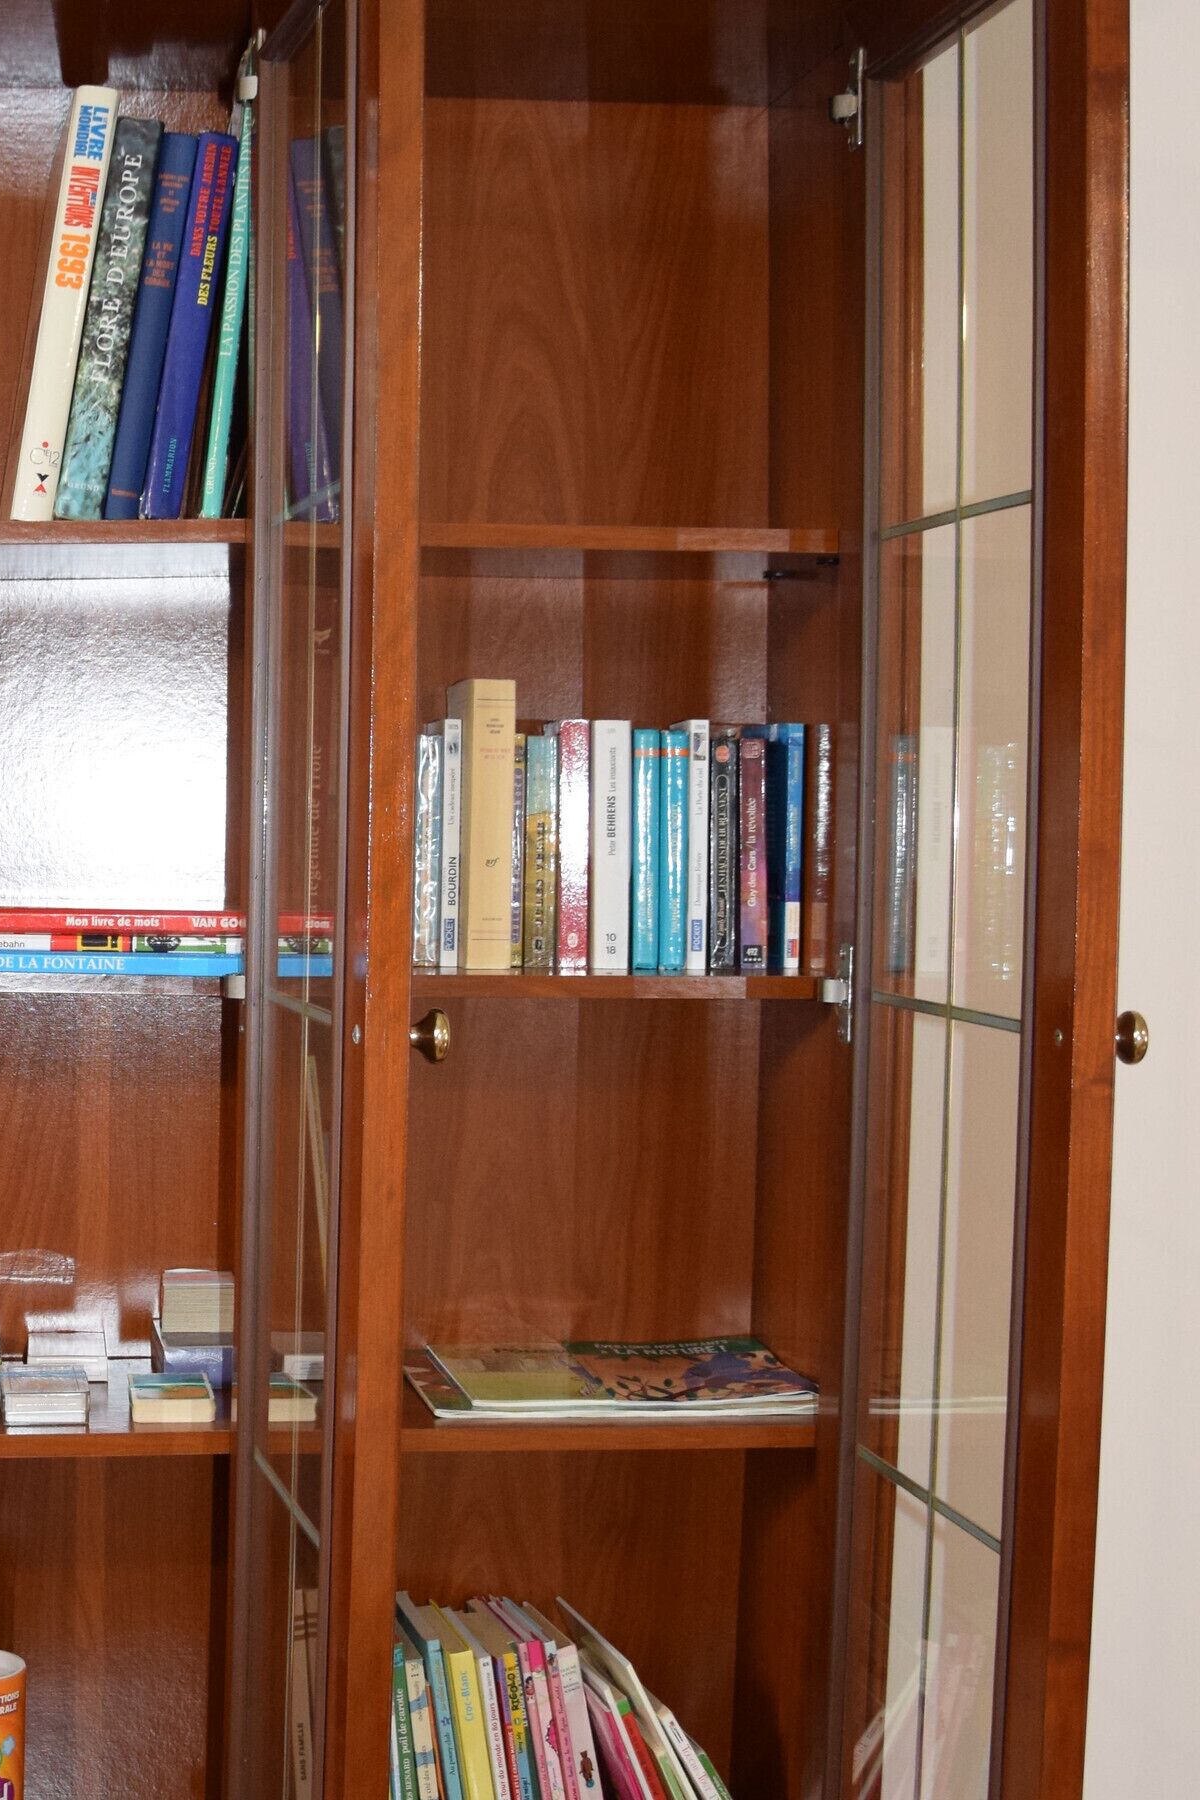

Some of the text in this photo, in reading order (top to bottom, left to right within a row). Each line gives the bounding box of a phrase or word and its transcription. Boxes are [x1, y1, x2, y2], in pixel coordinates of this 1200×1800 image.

[195, 189, 210, 226] VOTRE
[190, 225, 202, 257] DANS
[197, 194, 224, 306] DES FLEURS TOUTE
[55, 233, 91, 290] 1993
[91, 153, 143, 384] FLORE D'EUROPE
[220, 168, 249, 357] LA PASSION DES PLANTES
[606, 780, 617, 857] Peter BEHRENS Les
[747, 797, 757, 833] révoltée
[535, 822, 545, 928] JULES VERNE
[747, 850, 757, 871] Cars
[447, 856, 458, 906] BOURDIN
[747, 871, 757, 887] des
[747, 888, 758, 906] Guy
[65, 915, 218, 929] Mon livre de mots VAN
[444, 918, 455, 951] POCKET
[606, 933, 617, 941] 10
[691, 919, 703, 952] POCKET
[18, 957, 38, 969] LA
[43, 957, 125, 971] FONTAINE
[606, 945, 616, 955] 18
[644, 1346, 717, 1355] NATURE
[397, 1688, 408, 1724] carotte
[460, 1671, 474, 1722] Croc-Blanc
[507, 1674, 519, 1711] RIGOLO
[489, 1702, 498, 1720] jours
[491, 1721, 498, 1733] 80
[398, 1724, 408, 1735] de
[400, 1735, 411, 1754] poil
[494, 1743, 504, 1769] monde
[500, 1780, 508, 1798] Tour
